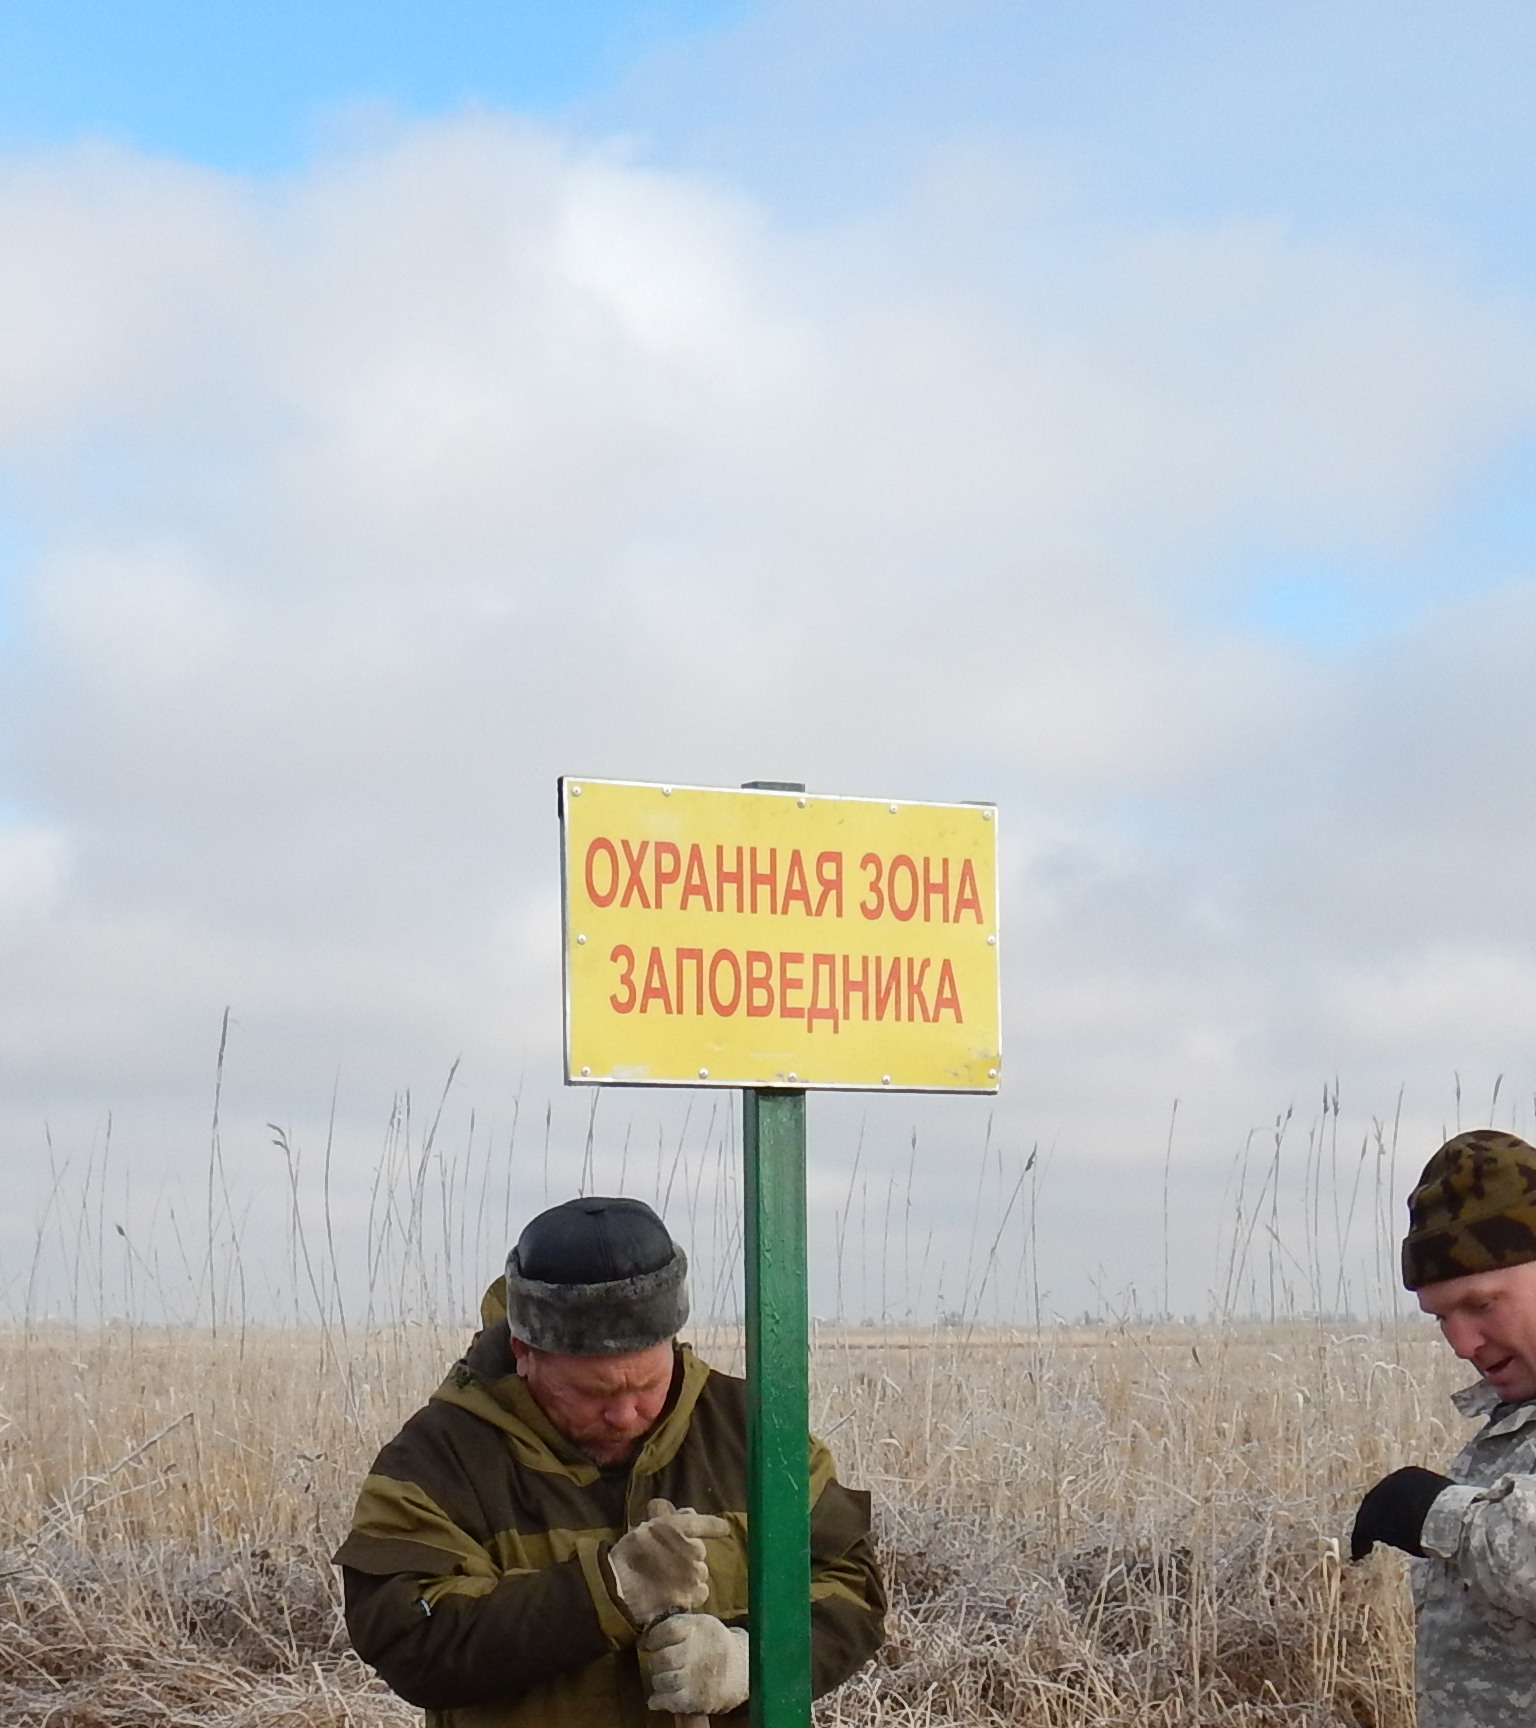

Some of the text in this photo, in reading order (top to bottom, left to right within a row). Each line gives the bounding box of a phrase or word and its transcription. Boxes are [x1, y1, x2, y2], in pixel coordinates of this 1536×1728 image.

[584, 836, 984, 925] ОХРАННАЯ ЗОНА
[608, 943, 964, 1035] ЗАПОВЕДНИКА
